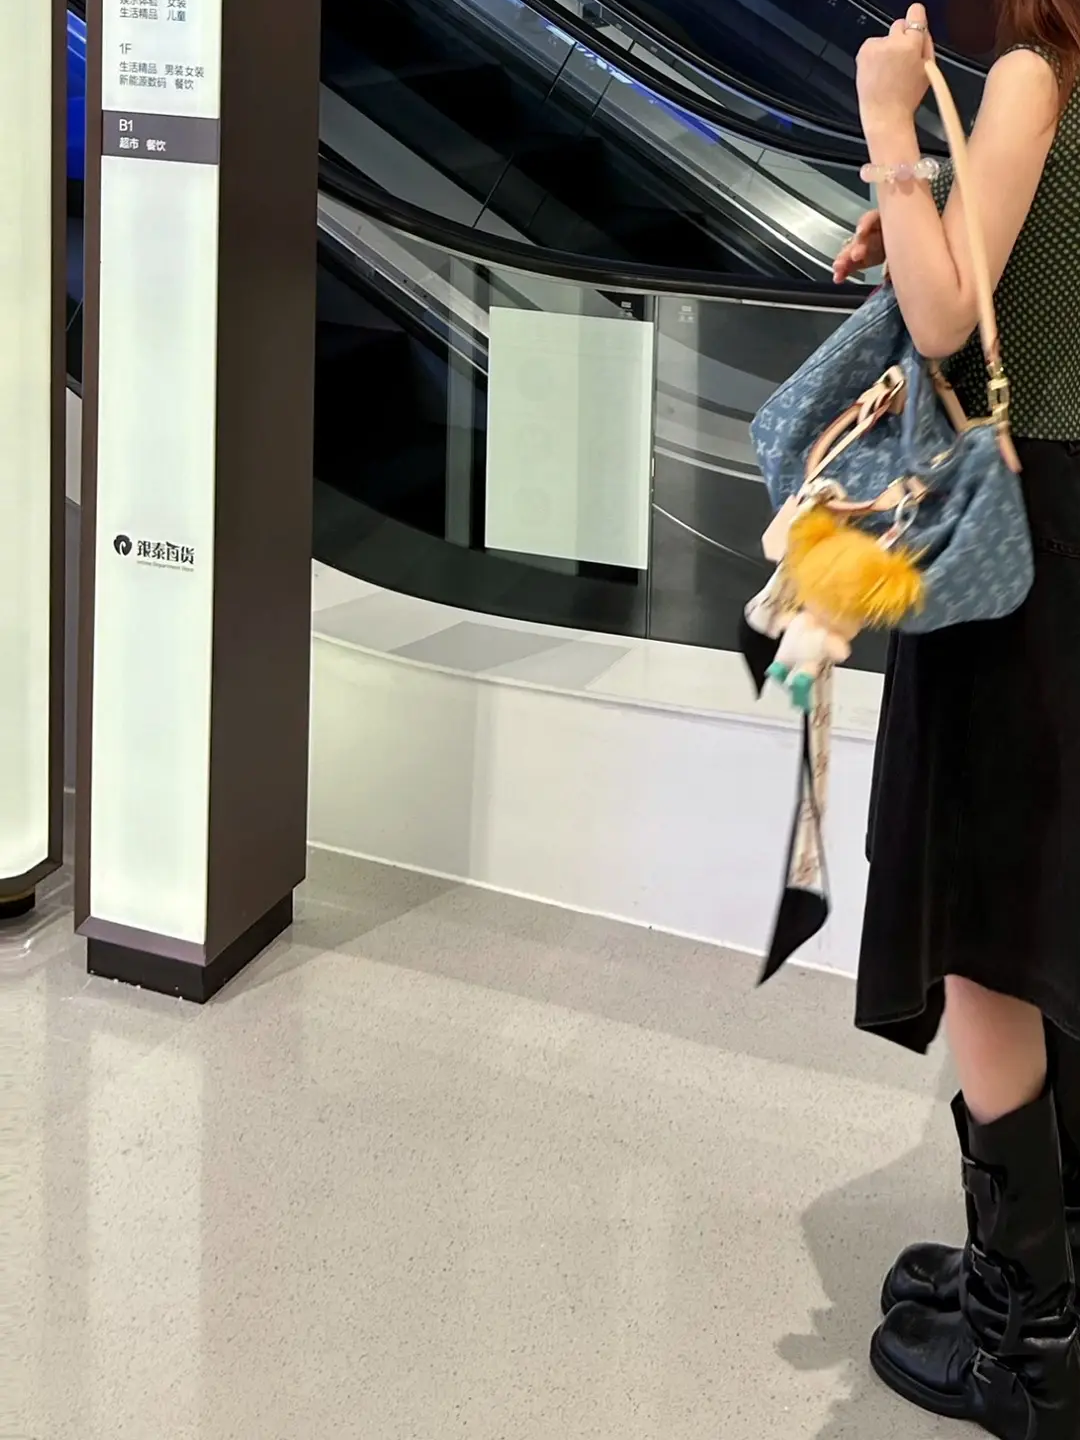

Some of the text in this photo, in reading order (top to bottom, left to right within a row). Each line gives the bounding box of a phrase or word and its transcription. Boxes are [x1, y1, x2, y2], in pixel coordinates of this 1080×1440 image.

[119, 6, 187, 22] 生活精品 儿童
[119, 43, 132, 55] 1F
[119, 61, 204, 78] 生活精品 男装女装
[119, 74, 194, 90] 新能源数码 餐饮
[119, 118, 133, 132] B1
[119, 137, 166, 152] 超市 餐饮
[137, 540, 195, 565] 银泰百货
